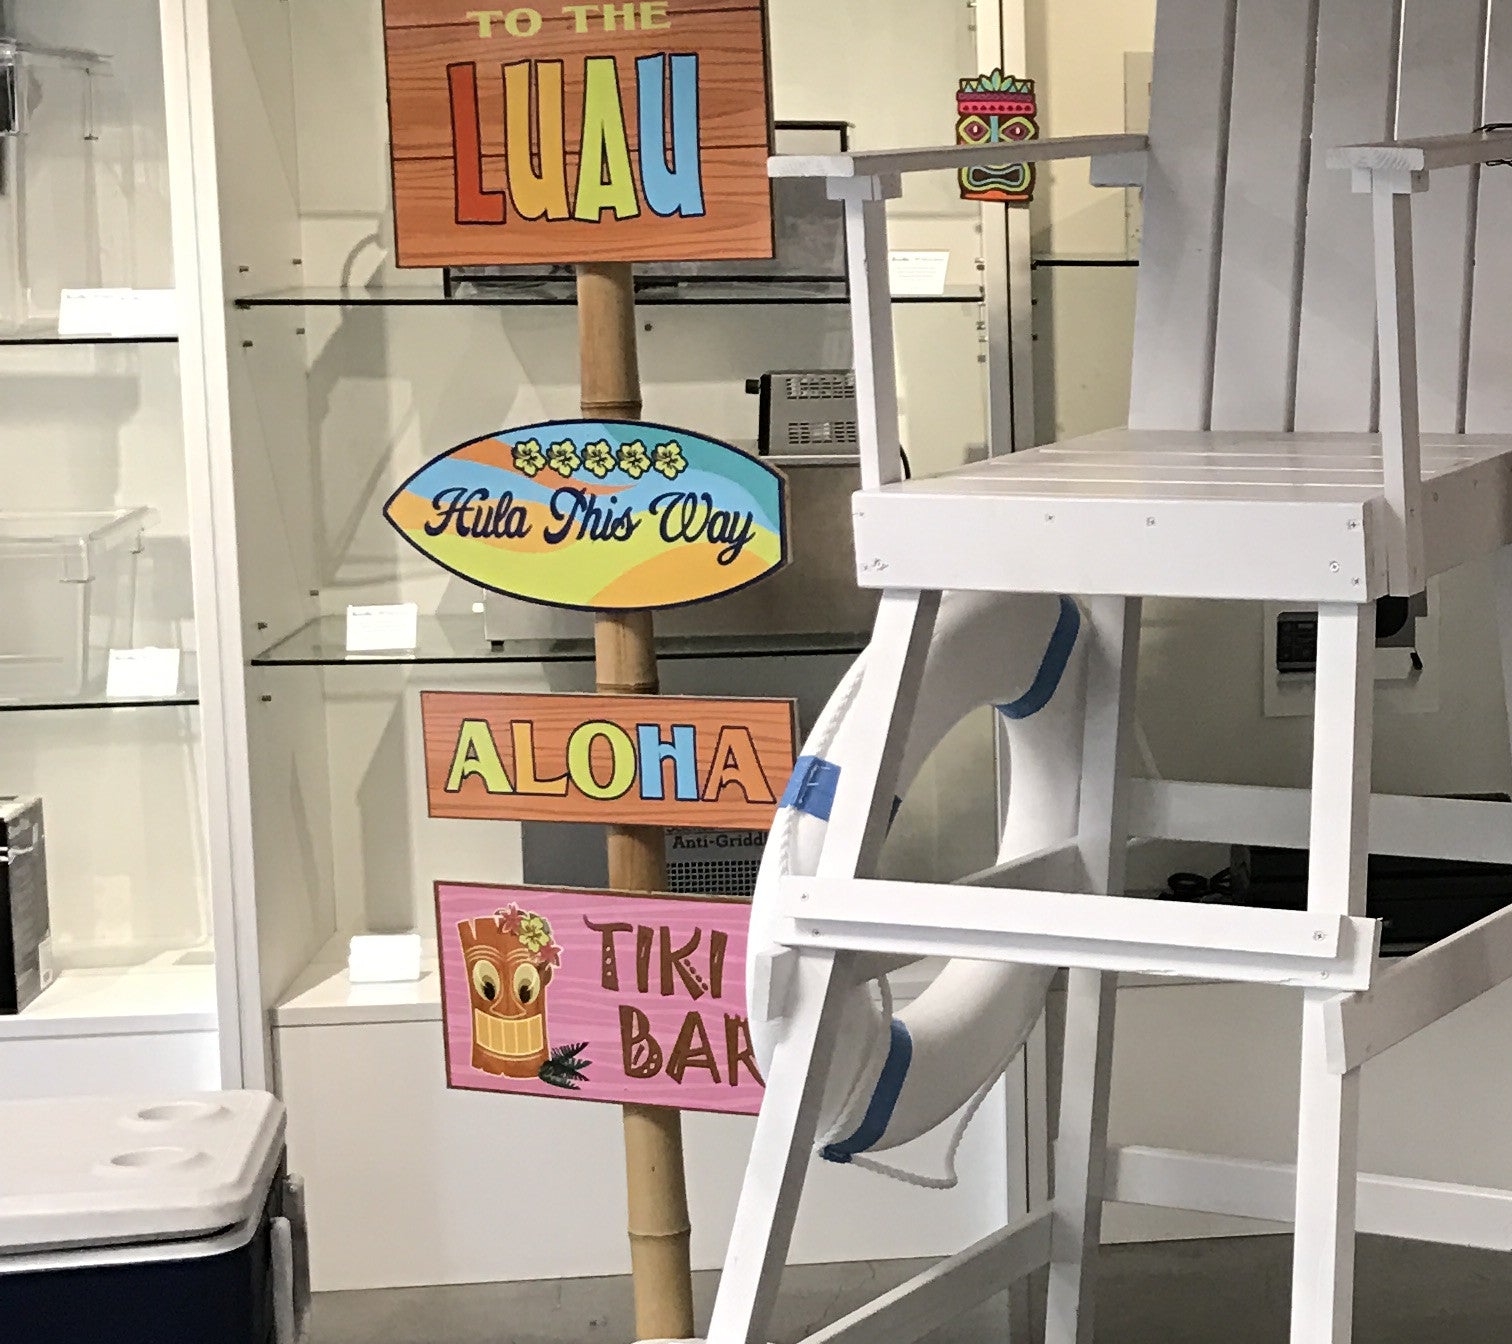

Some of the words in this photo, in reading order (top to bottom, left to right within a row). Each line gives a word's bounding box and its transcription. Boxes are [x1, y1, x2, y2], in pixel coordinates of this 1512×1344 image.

[465, 7, 543, 39] TO
[561, 0, 672, 34] THE
[446, 51, 707, 225] LUAU
[424, 486, 532, 537] Hula
[543, 486, 643, 545] This
[649, 492, 756, 566] Way
[444, 718, 777, 805] ALOHA
[583, 914, 728, 1001] TIKI
[618, 1004, 766, 1088] BAR
